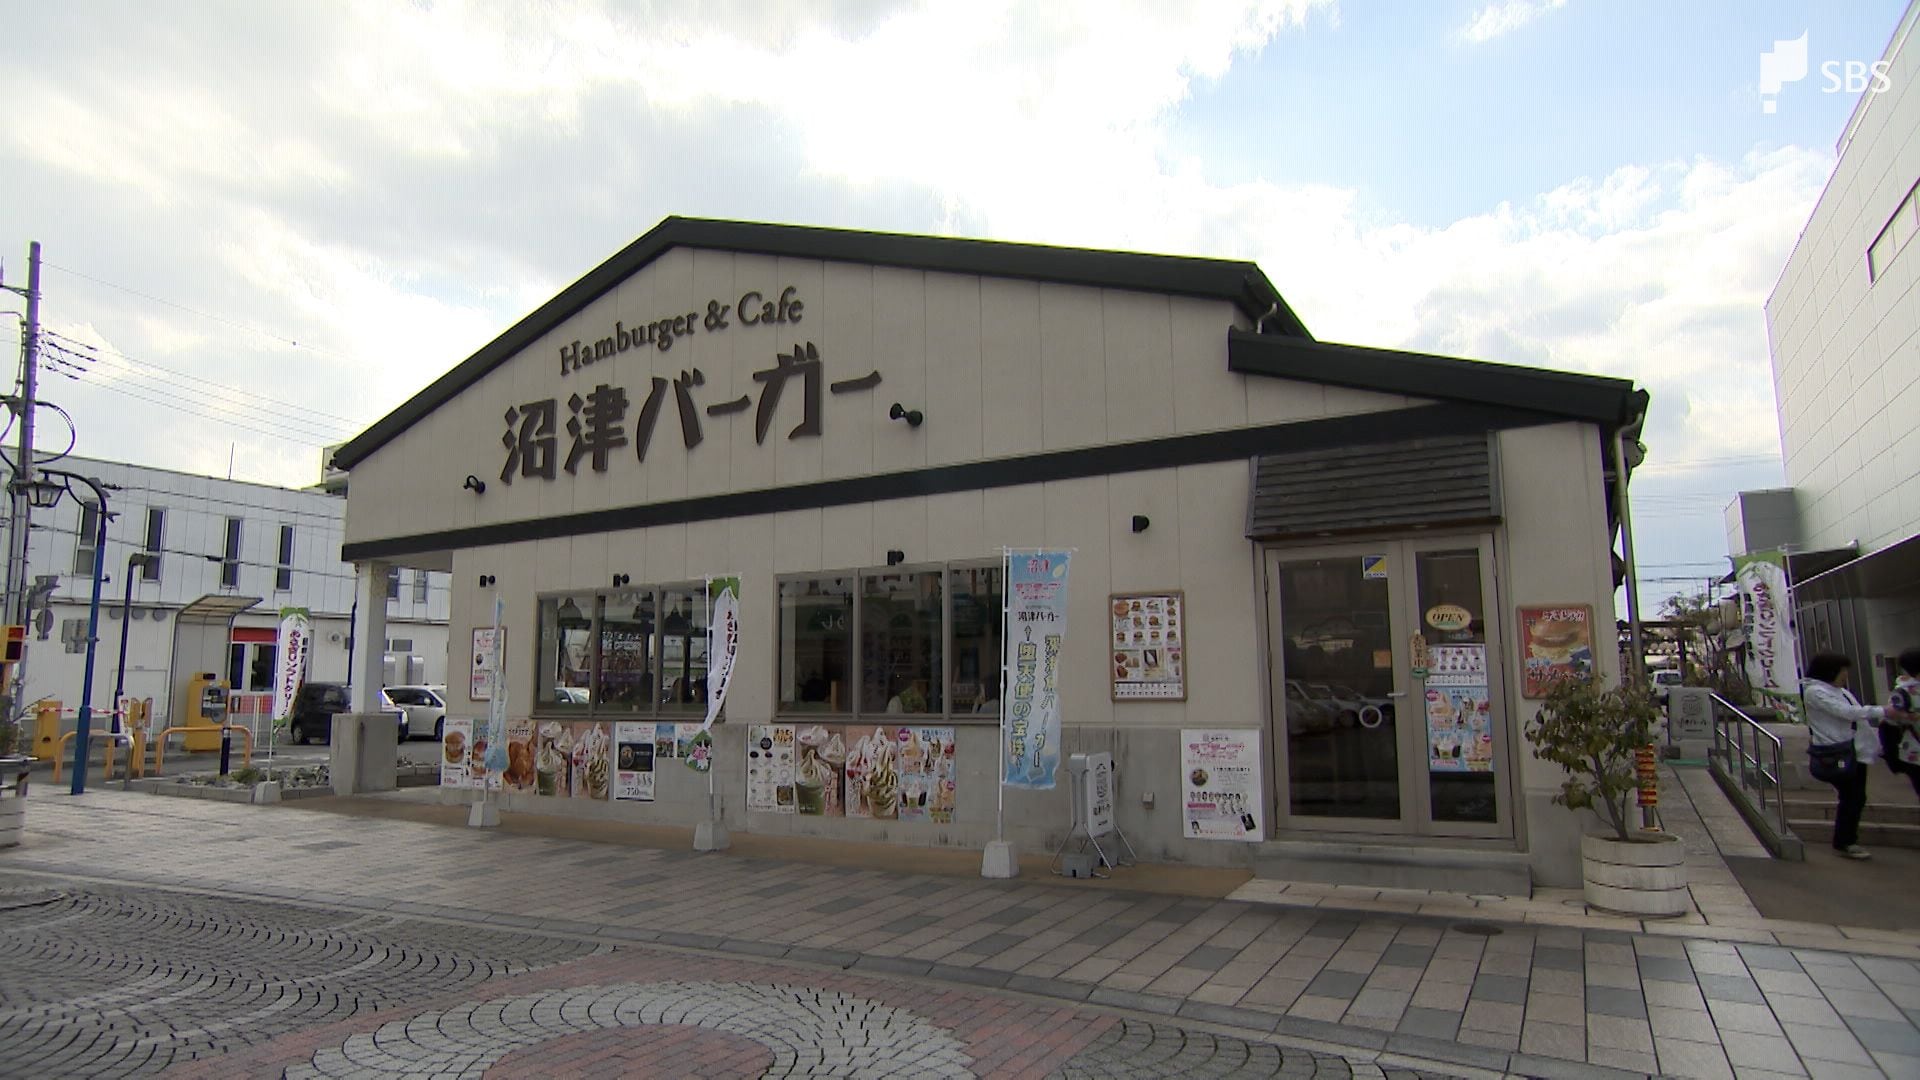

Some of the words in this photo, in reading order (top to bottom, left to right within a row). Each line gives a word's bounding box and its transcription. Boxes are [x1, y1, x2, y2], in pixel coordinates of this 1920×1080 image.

[558, 308, 699, 376] Hamburger
[704, 298, 730, 333] &
[737, 285, 805, 327] Cafe
[499, 340, 883, 485] 沼津バーガー
[1432, 613, 1465, 622] OPEN
